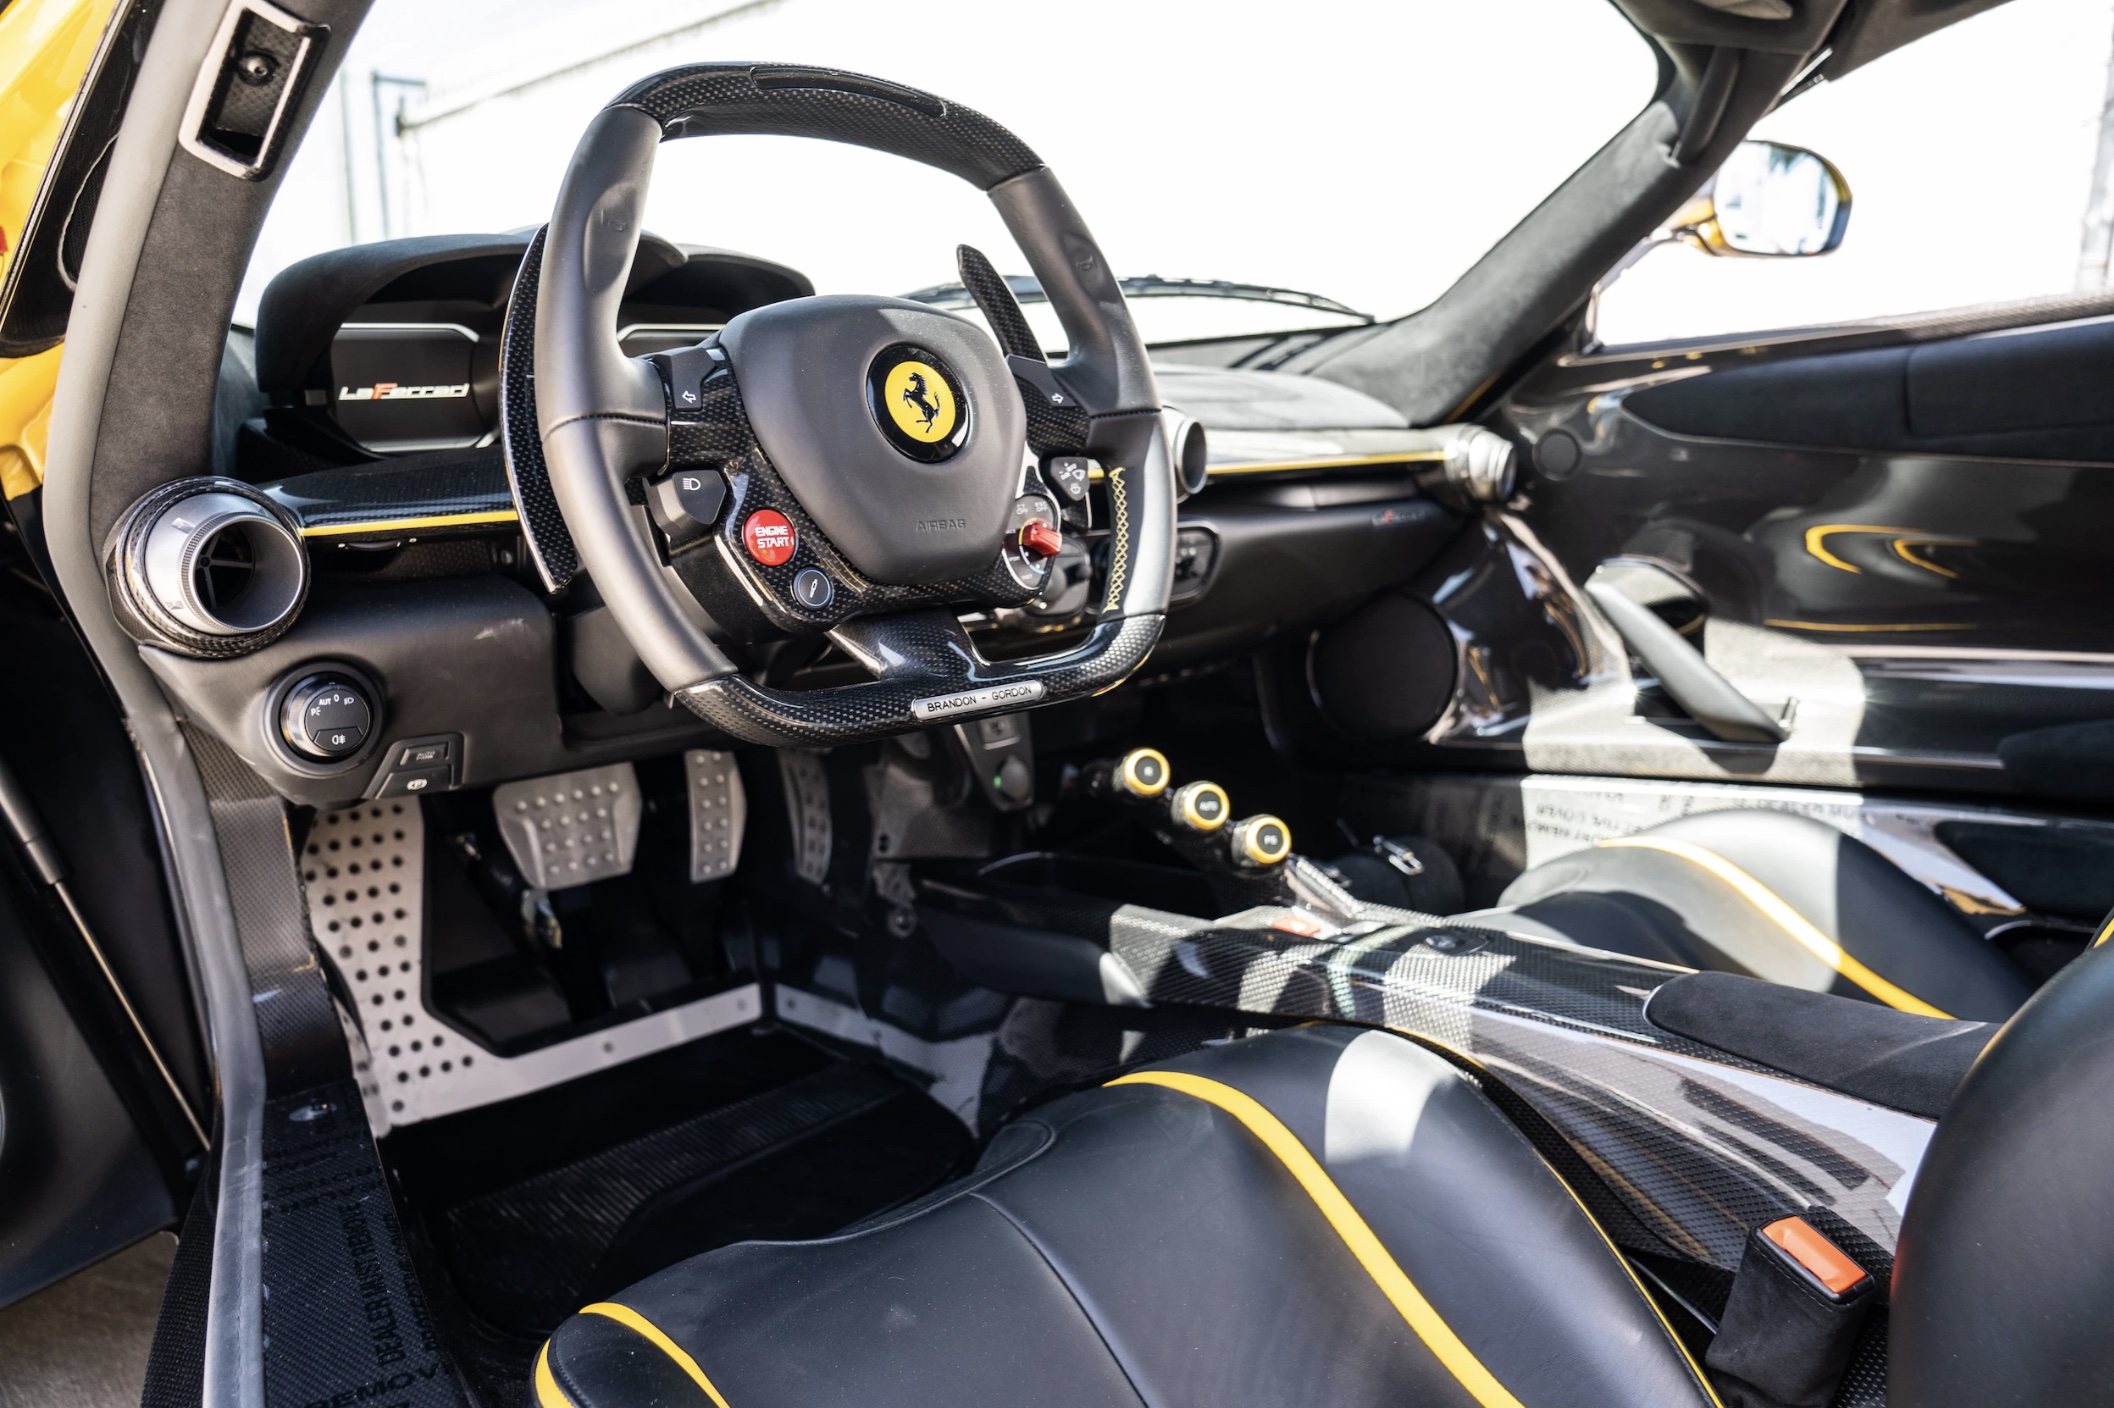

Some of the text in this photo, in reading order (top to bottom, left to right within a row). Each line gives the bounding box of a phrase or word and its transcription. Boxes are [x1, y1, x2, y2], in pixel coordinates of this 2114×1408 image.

[755, 525, 788, 537] ENGINE
[915, 518, 966, 533] AIRBAG
[757, 537, 790, 549] START
[926, 695, 977, 712] BRANDON
[991, 686, 1032, 700] GORDON
[363, 1297, 407, 1367] DEALER
